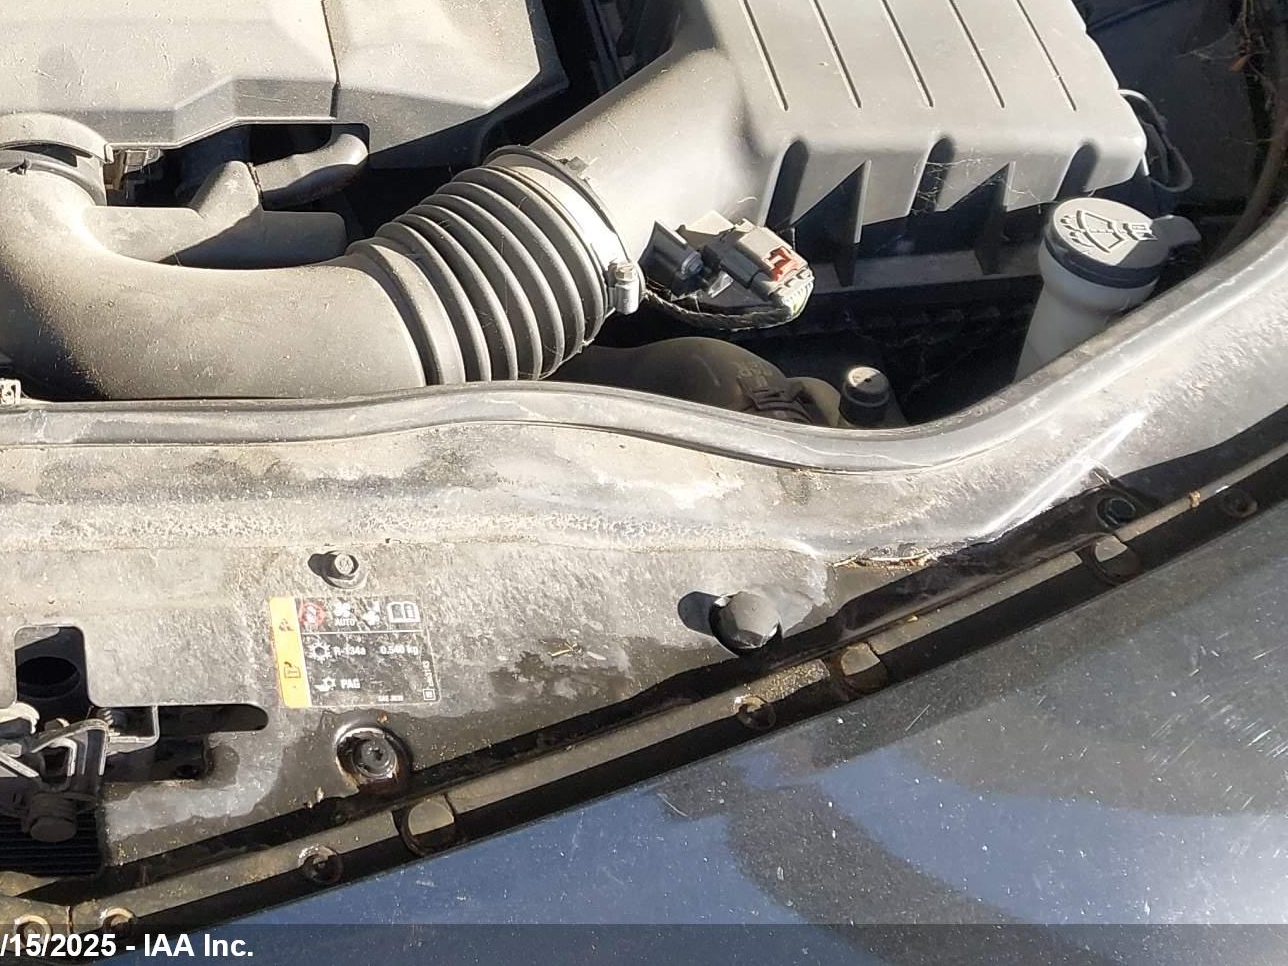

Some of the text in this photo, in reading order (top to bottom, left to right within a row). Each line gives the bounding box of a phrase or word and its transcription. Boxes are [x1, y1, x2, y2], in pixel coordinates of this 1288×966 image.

[335, 618, 355, 626] AUTO
[333, 645, 367, 655] R-134a
[340, 678, 361, 689] PAG
